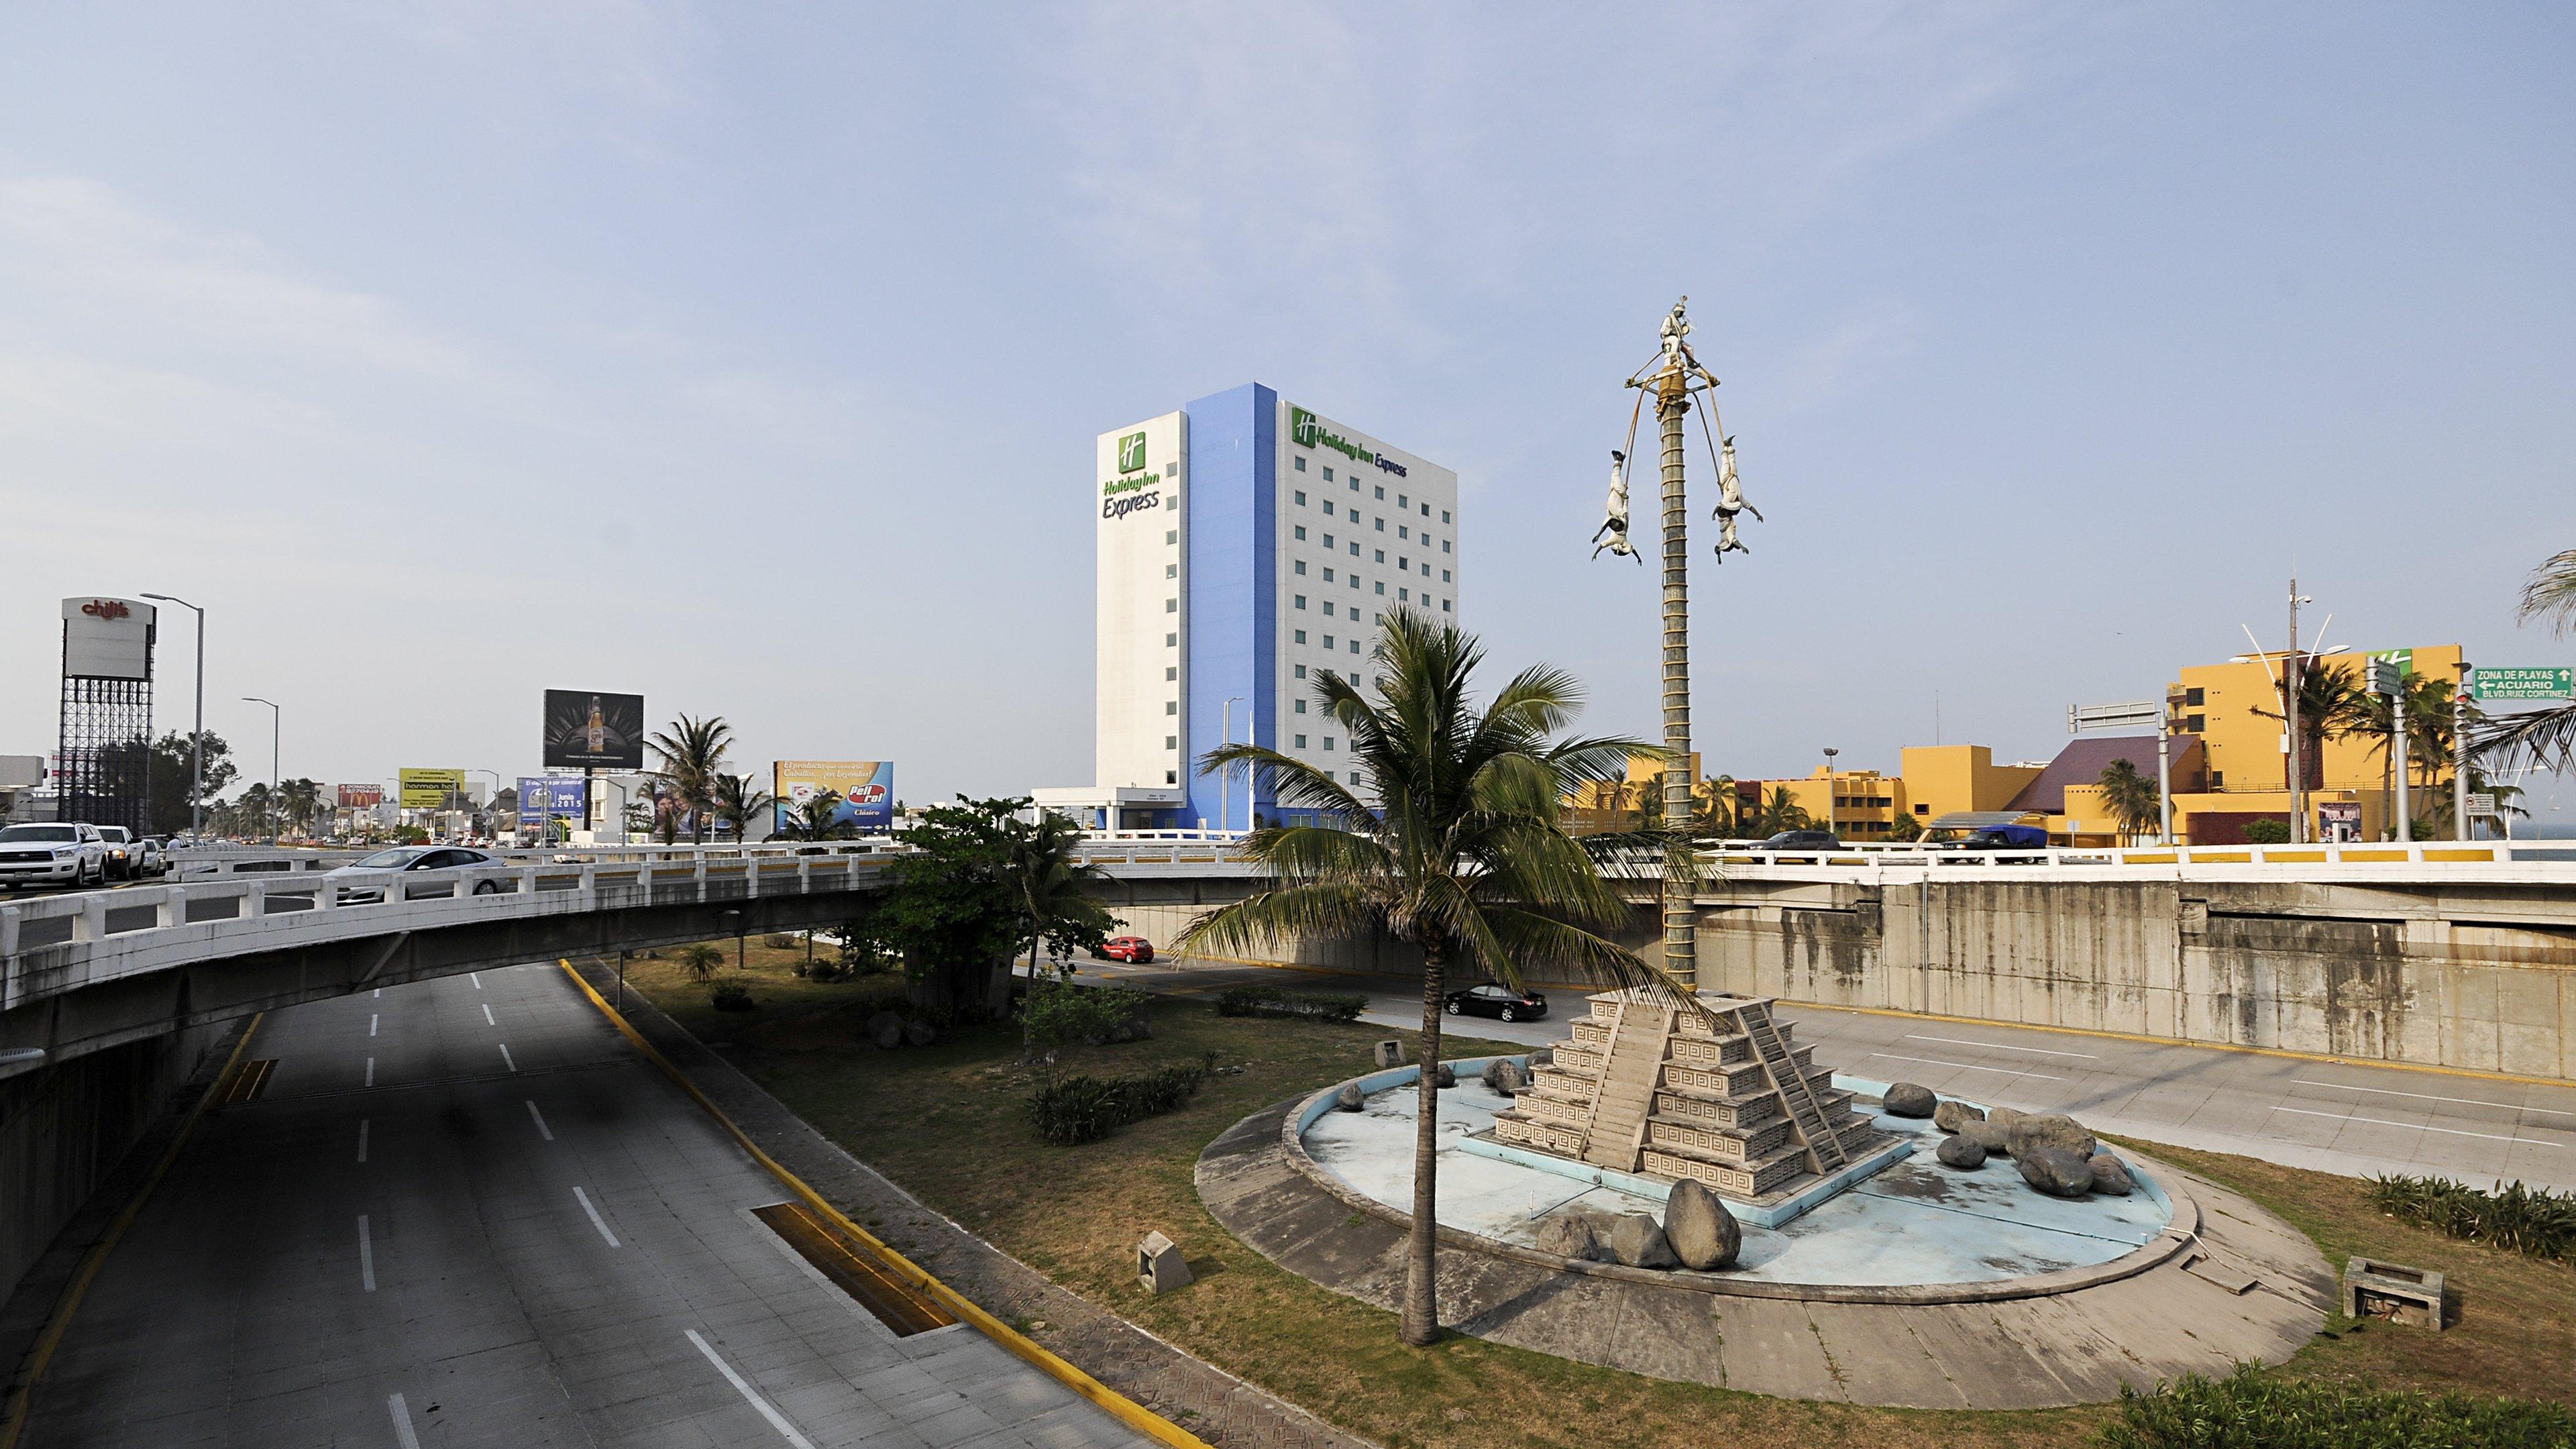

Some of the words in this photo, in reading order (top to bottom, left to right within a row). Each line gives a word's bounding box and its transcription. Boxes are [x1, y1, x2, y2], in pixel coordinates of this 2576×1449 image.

[1317, 427, 1357, 460] Holiday
[1358, 443, 1374, 464] Inn
[1375, 453, 1407, 477] Express
[1104, 476, 1142, 496] Holiday
[1142, 472, 1159, 486] Inn
[1103, 490, 1159, 520] Express
[2477, 671, 2502, 680] ZONA
[2504, 671, 2516, 680] DE
[2518, 671, 2554, 680] PLAYAS
[2496, 681, 2553, 689] ACUARIO
[2527, 690, 2568, 698] CORTINEZ
[792, 761, 824, 770] producto
[849, 785, 872, 796] Pell
[863, 793, 883, 803] rol
